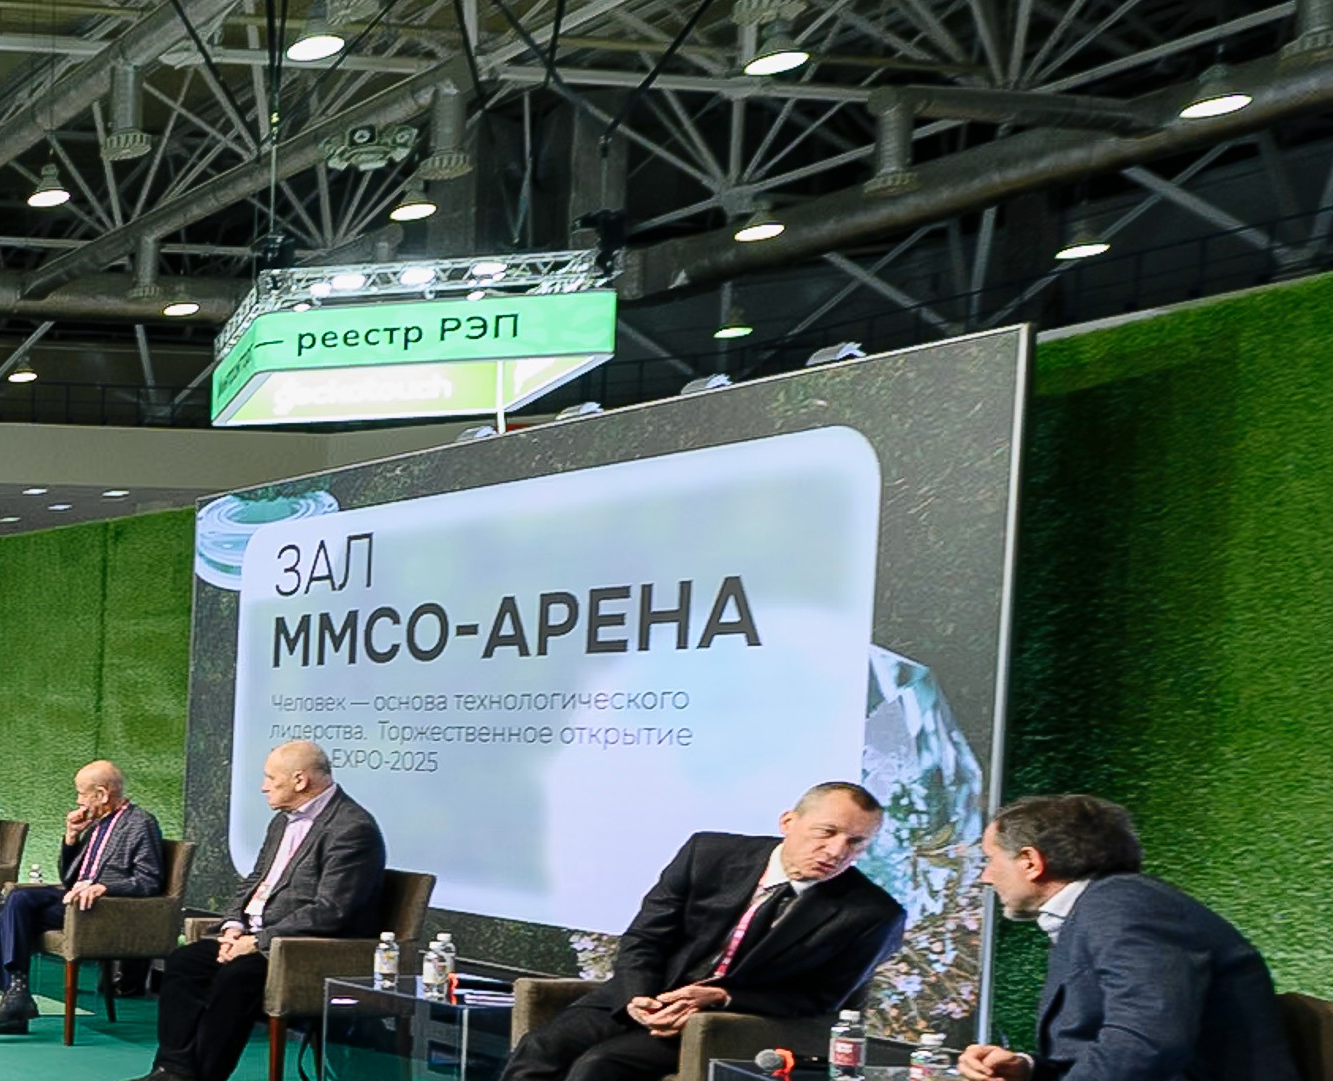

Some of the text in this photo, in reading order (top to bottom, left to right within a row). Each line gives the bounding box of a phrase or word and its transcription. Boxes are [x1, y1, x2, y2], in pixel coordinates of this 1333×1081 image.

[297, 324, 423, 356] реестр
[439, 313, 520, 342] РЭП
[275, 532, 374, 597] ЗАЛ
[272, 575, 762, 668] ММСО-АРЕНА
[271, 694, 347, 712] Человек
[373, 694, 448, 712] основа
[453, 691, 691, 712] технологического
[269, 720, 694, 750] лидерства. Торжественное открытие
[331, 748, 439, 773] EXPO-2025
